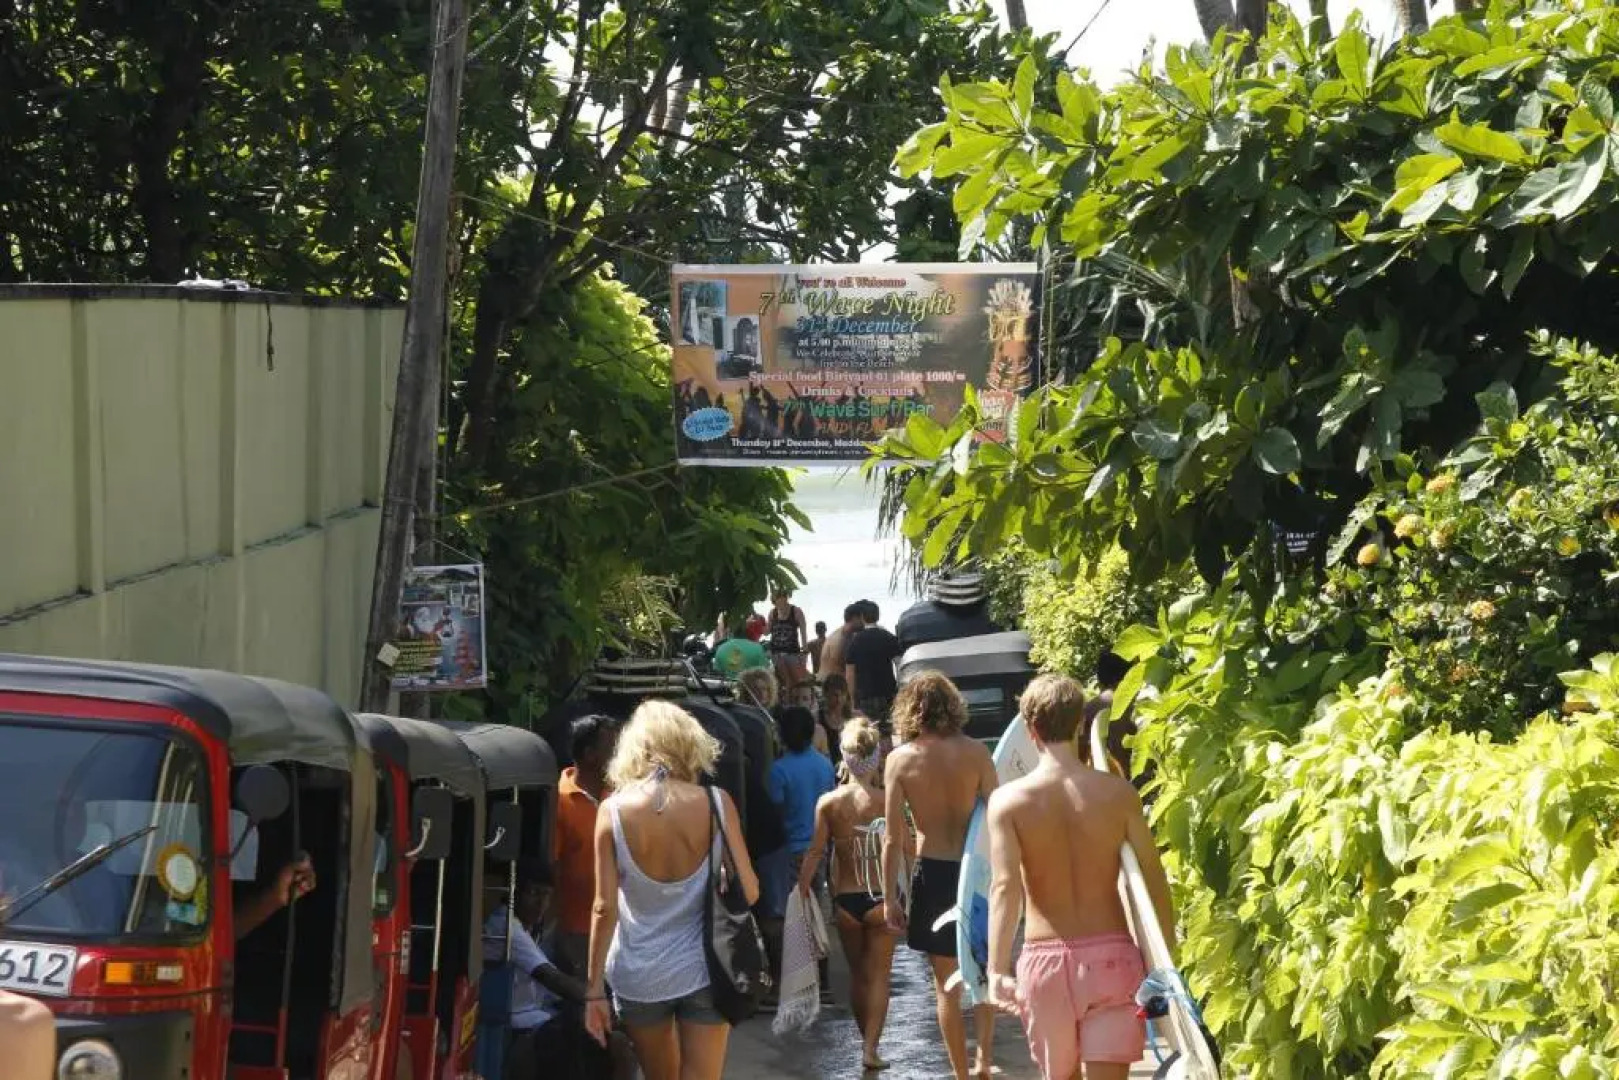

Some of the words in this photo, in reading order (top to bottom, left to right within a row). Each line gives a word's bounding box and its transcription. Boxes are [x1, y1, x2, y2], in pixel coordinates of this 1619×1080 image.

[856, 276, 907, 289] Welcome
[804, 290, 875, 317] Wave
[879, 289, 956, 322] Night
[833, 316, 916, 334] December
[748, 370, 796, 383] Special
[892, 371, 923, 384] plate
[801, 386, 842, 397] Drinks
[810, 403, 856, 417] Wave
